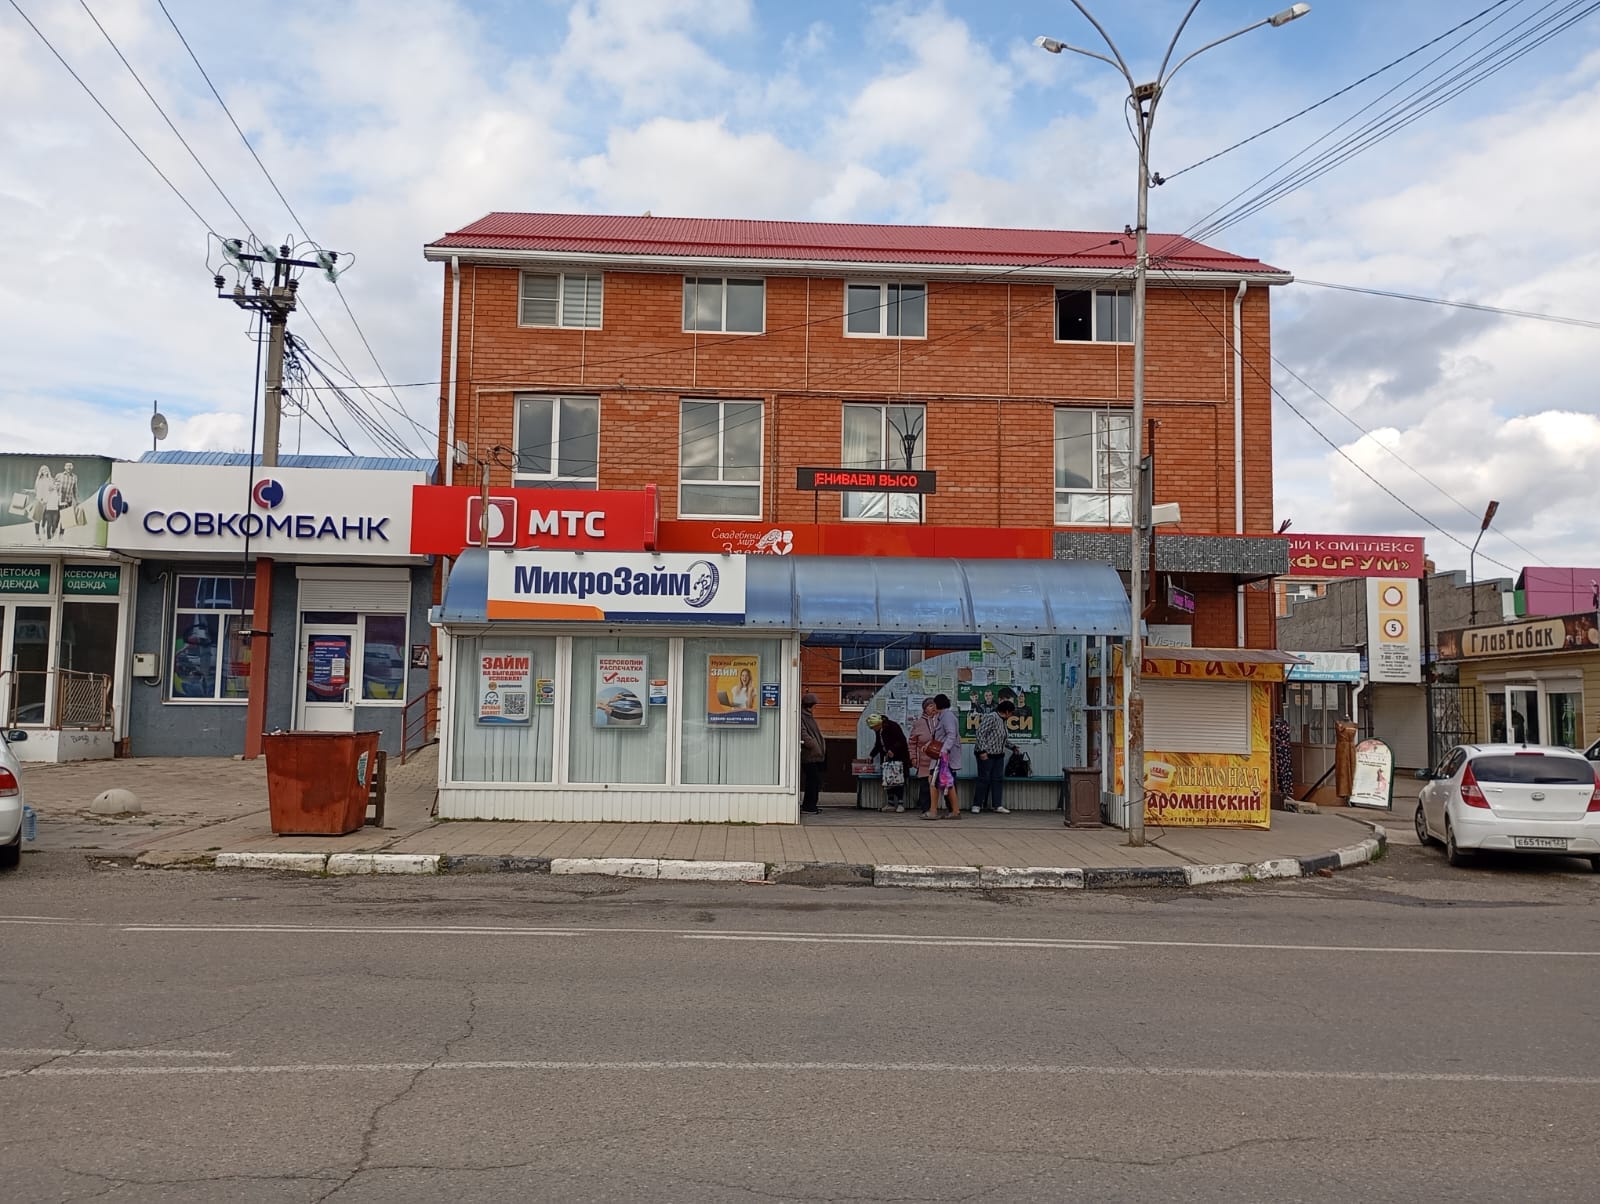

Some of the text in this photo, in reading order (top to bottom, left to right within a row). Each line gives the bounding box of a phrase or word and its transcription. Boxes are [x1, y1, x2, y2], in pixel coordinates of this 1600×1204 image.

[879, 474, 918, 488] ВЫСО
[143, 510, 390, 541] СОВКОМБАНК
[528, 509, 606, 538] МТС
[711, 528, 761, 540] Свадебный
[1316, 541, 1415, 553] КОМПЛЕКС
[67, 580, 107, 590] ОДЕЖДА
[514, 564, 691, 600] МикроЗайм
[1391, 623, 1397, 632] 5
[1471, 627, 1553, 653] ГлавТабак
[482, 654, 529, 670] ЗАЙМ
[1176, 766, 1262, 792] ЛИМОНАД
[1147, 790, 1261, 815] ароминский
